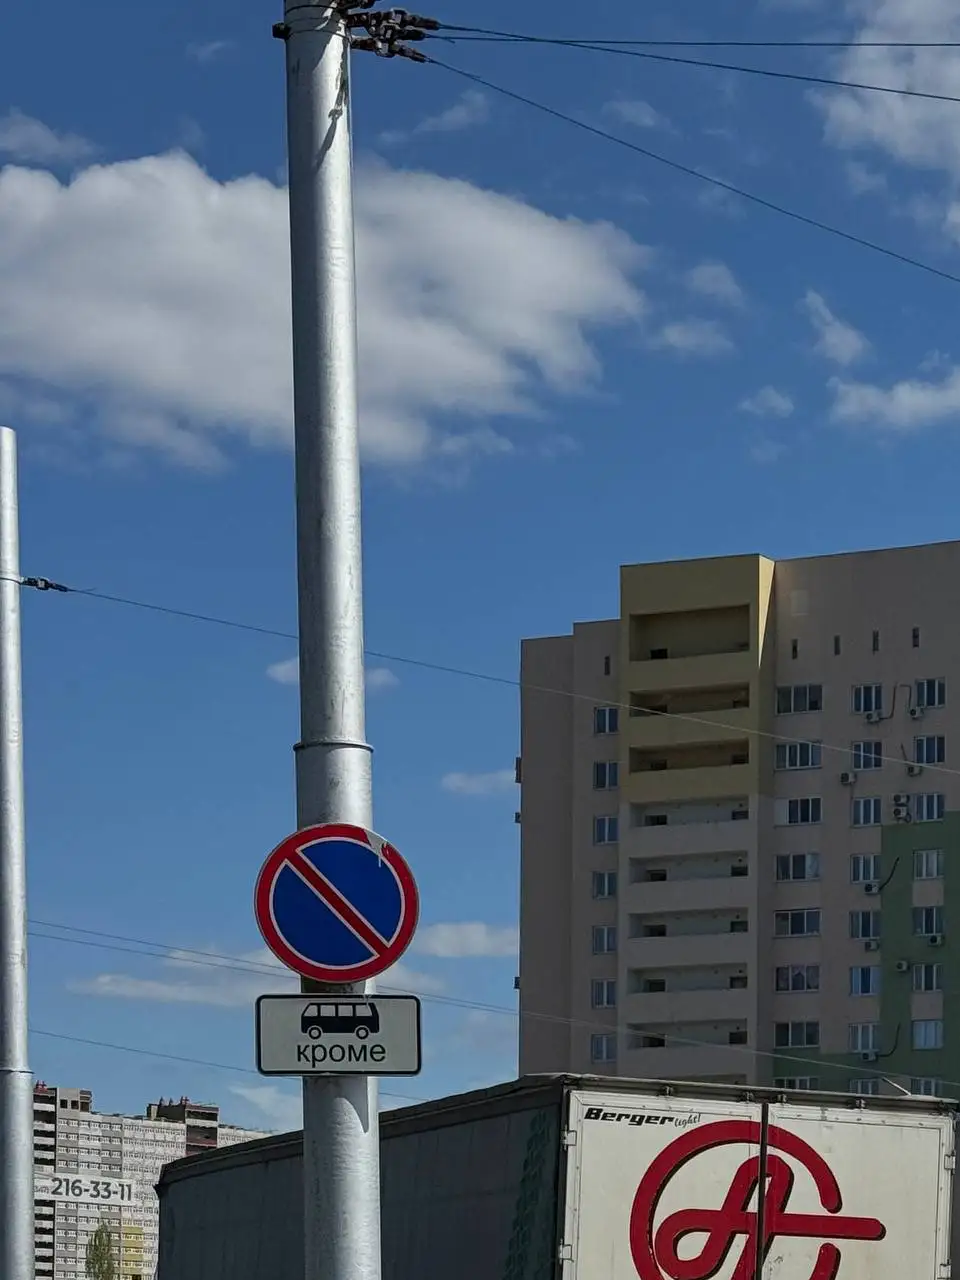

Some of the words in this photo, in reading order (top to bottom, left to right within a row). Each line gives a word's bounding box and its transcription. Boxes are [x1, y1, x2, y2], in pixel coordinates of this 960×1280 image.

[297, 1044, 386, 1068] кроме
[584, 1107, 675, 1126] Berger
[51, 1177, 132, 1201] 216-33-11
